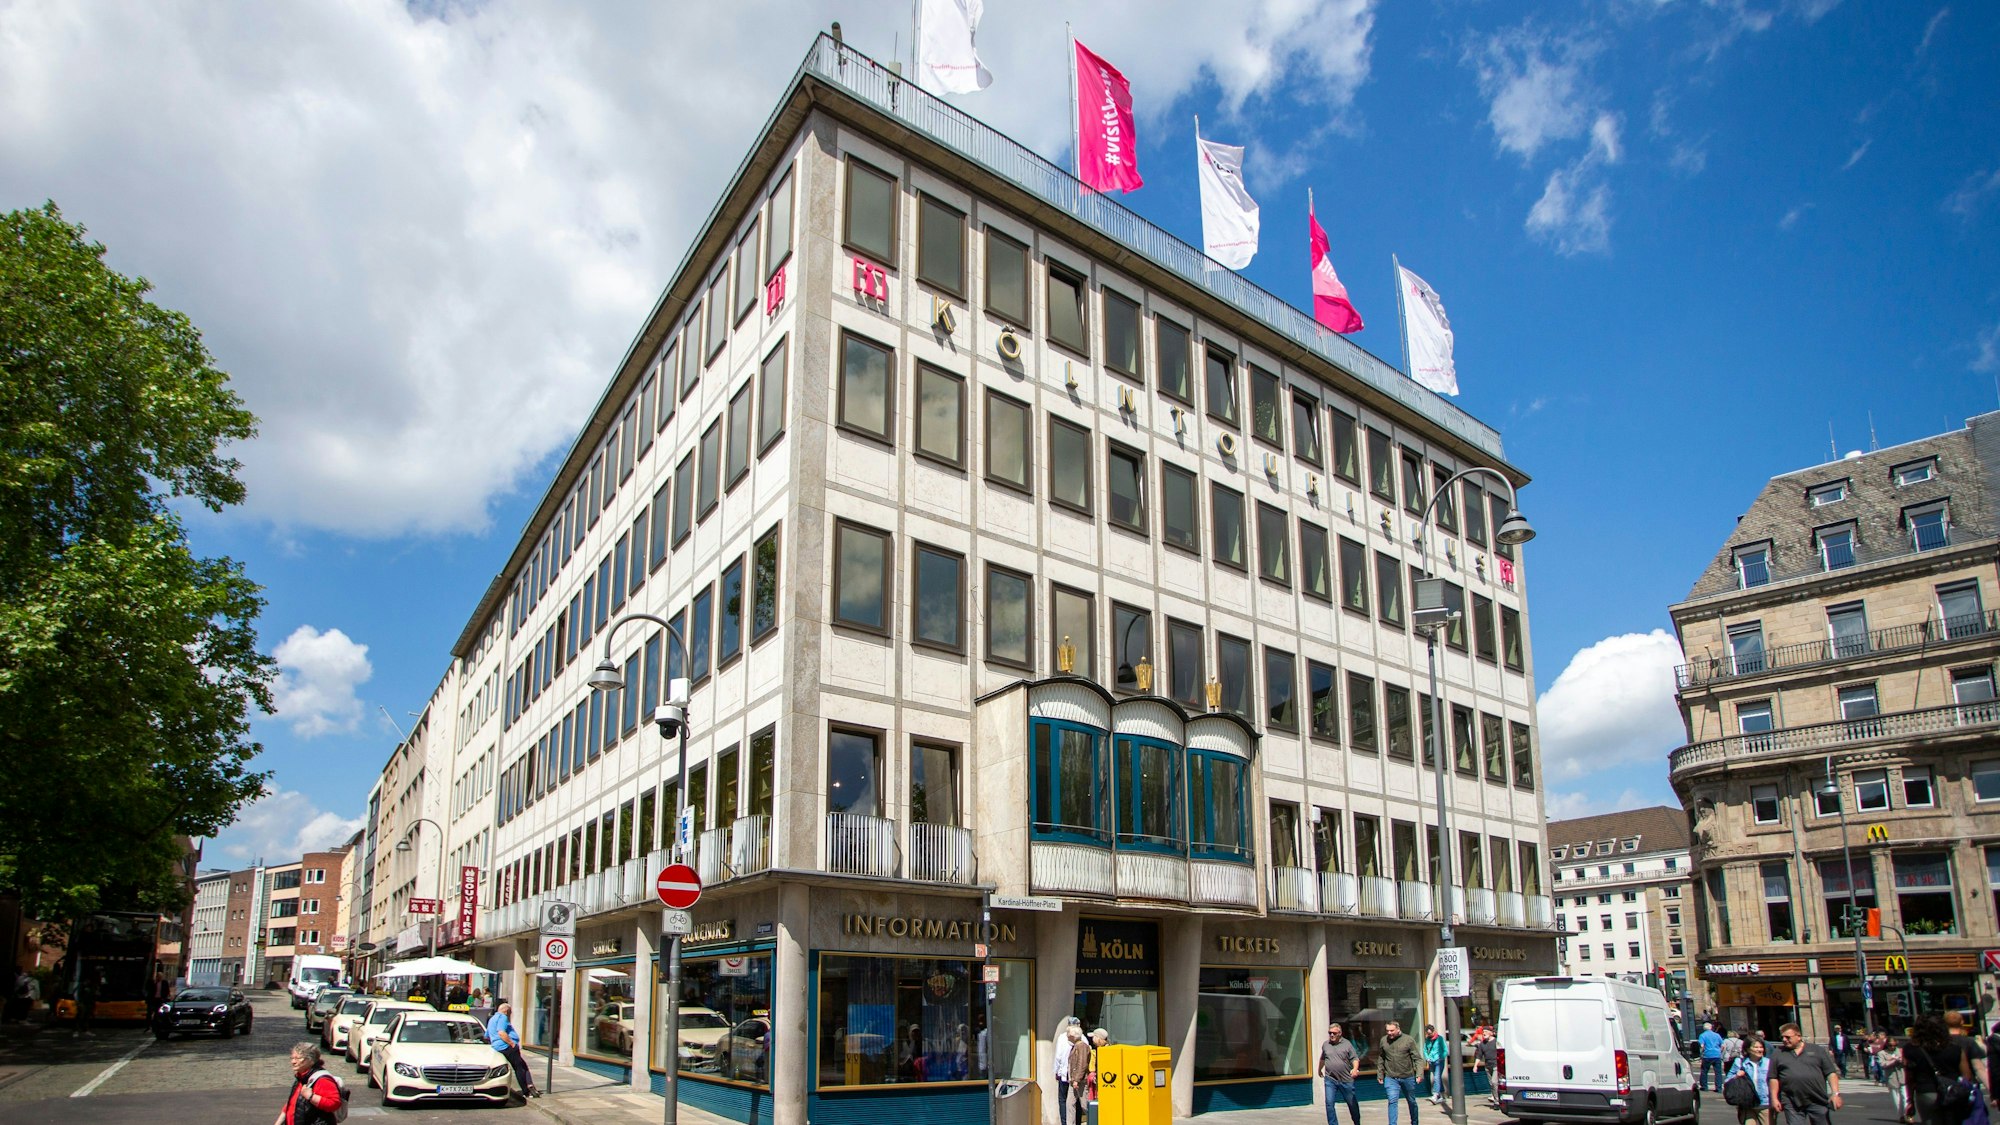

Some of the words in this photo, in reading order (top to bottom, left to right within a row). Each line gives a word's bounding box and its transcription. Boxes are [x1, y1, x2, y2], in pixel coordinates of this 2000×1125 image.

[462, 877, 475, 935] SOUVENIRS
[997, 897, 1057, 909] Kardinal-Höffner-Platz
[844, 914, 1016, 942] INFORMATION
[550, 944, 564, 955] 30
[1100, 938, 1144, 960] KÖLN
[1218, 936, 1280, 954] TICKETS
[1354, 940, 1403, 957] SERVICE
[1473, 946, 1528, 961] SOUVENIRS
[1443, 954, 1458, 963] 800
